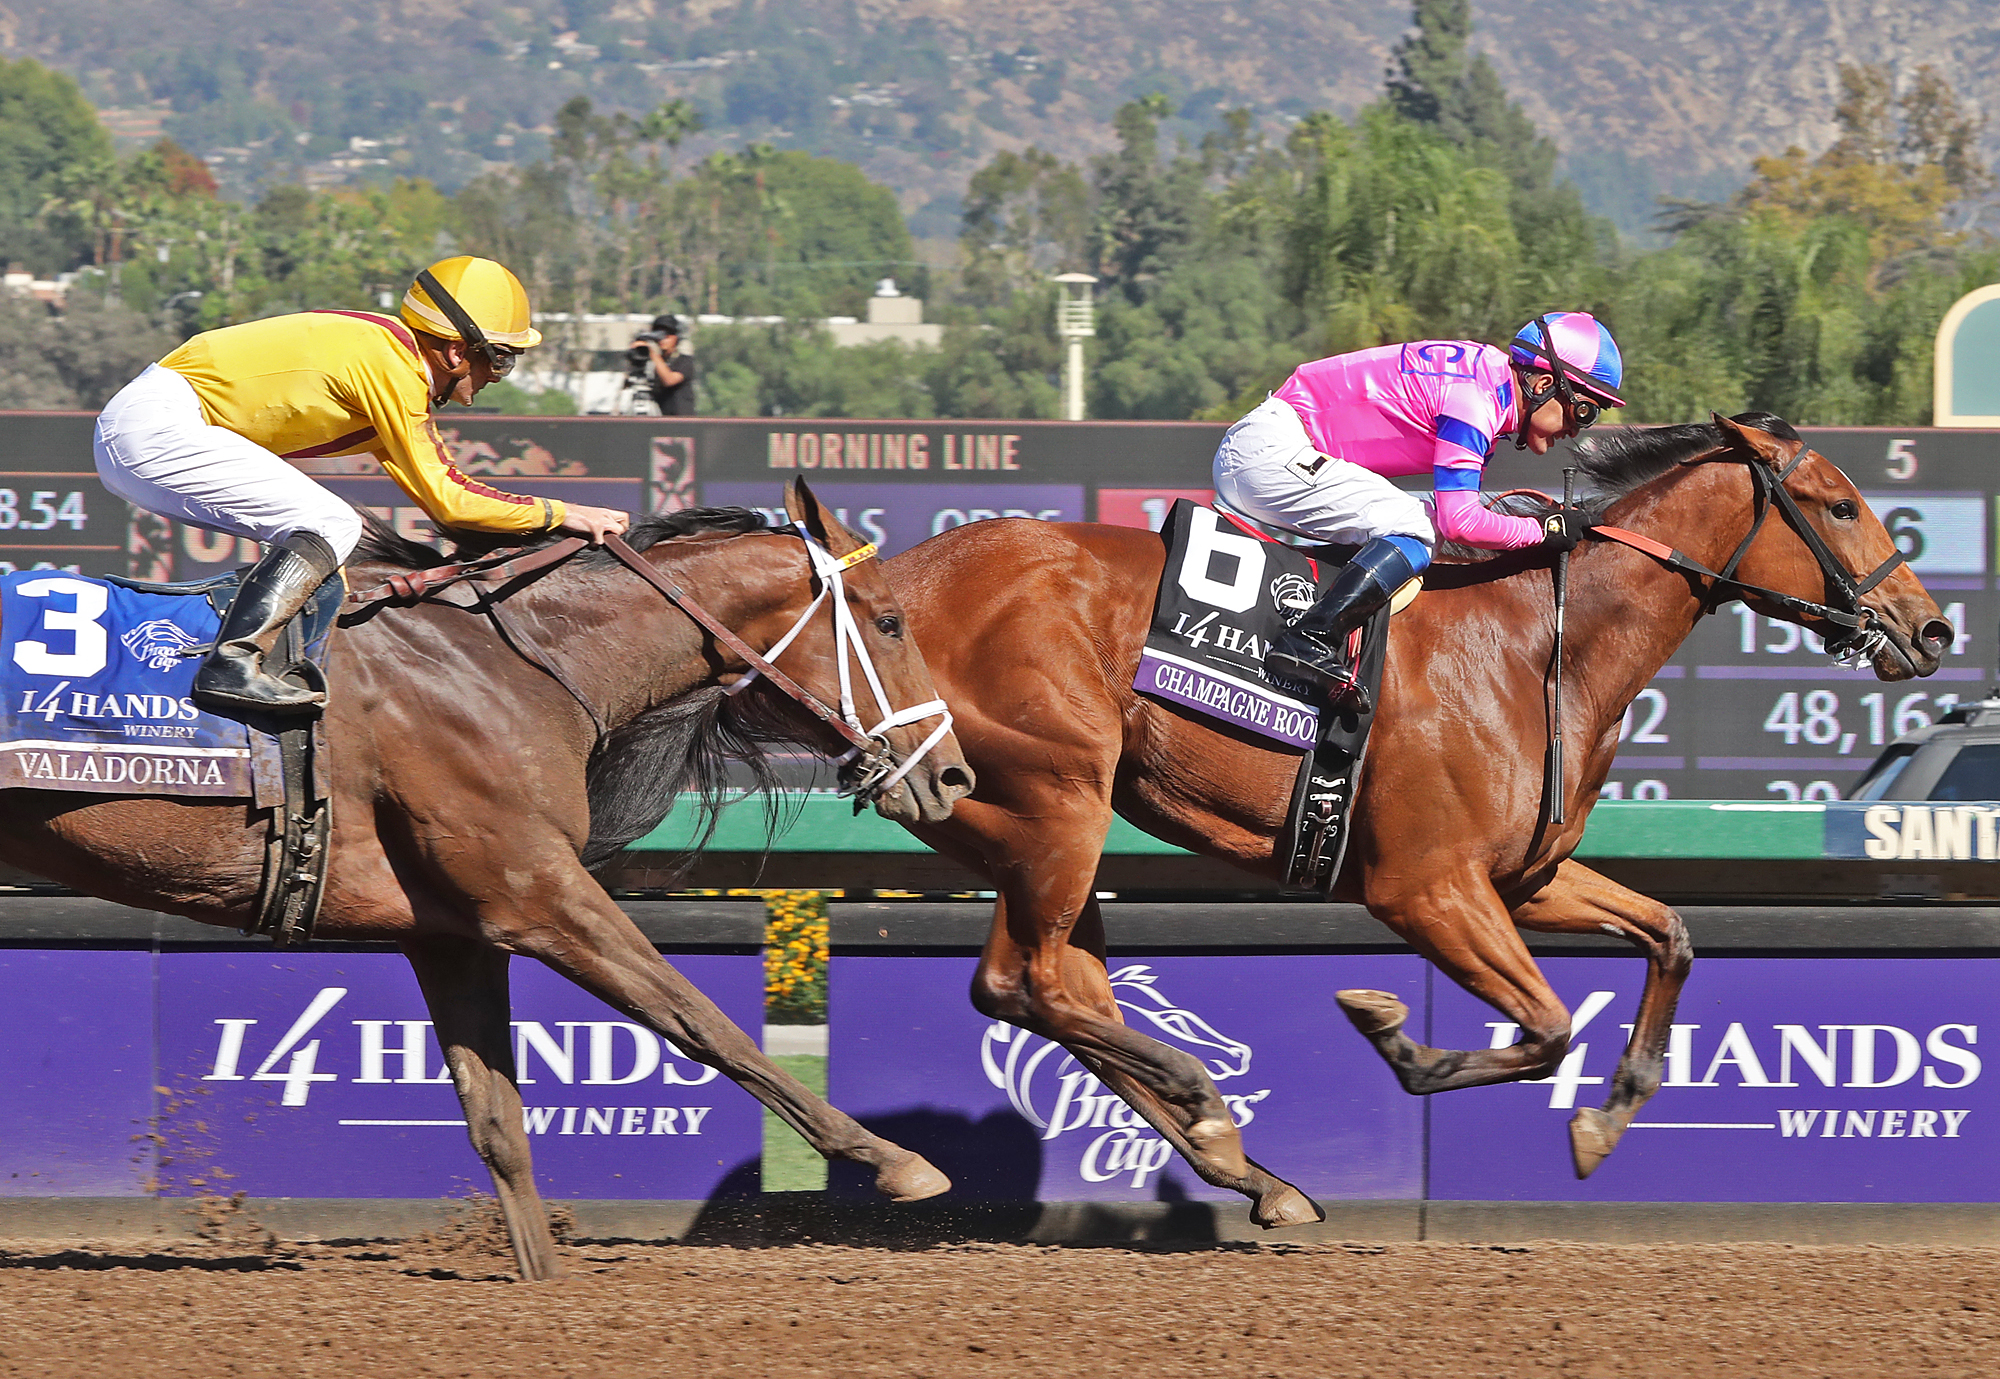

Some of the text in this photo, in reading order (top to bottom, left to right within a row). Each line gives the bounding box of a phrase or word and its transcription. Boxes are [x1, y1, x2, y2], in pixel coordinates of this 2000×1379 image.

[768, 433, 1021, 470] MORNING LINE
[1886, 439, 1918, 480] 5
[1884, 507, 1924, 562] 6
[1178, 506, 1267, 613] 6
[13, 578, 108, 677] 3
[1171, 611, 1220, 648] 14
[18, 681, 199, 722] 14 HANDS
[1155, 664, 1272, 727] CHAMPAGNE
[1258, 666, 1311, 696] WINERY
[123, 724, 199, 739] WINERY
[15, 752, 226, 786] VALADORNA
[1864, 805, 2000, 860] SANT
[201, 988, 720, 1106] 14 HNDS
[1619, 1022, 1982, 1088] HANDS
[521, 1107, 712, 1135] WINERY
[1777, 1110, 1971, 1138] WINERY
[1080, 1128, 1173, 1188] Cup
